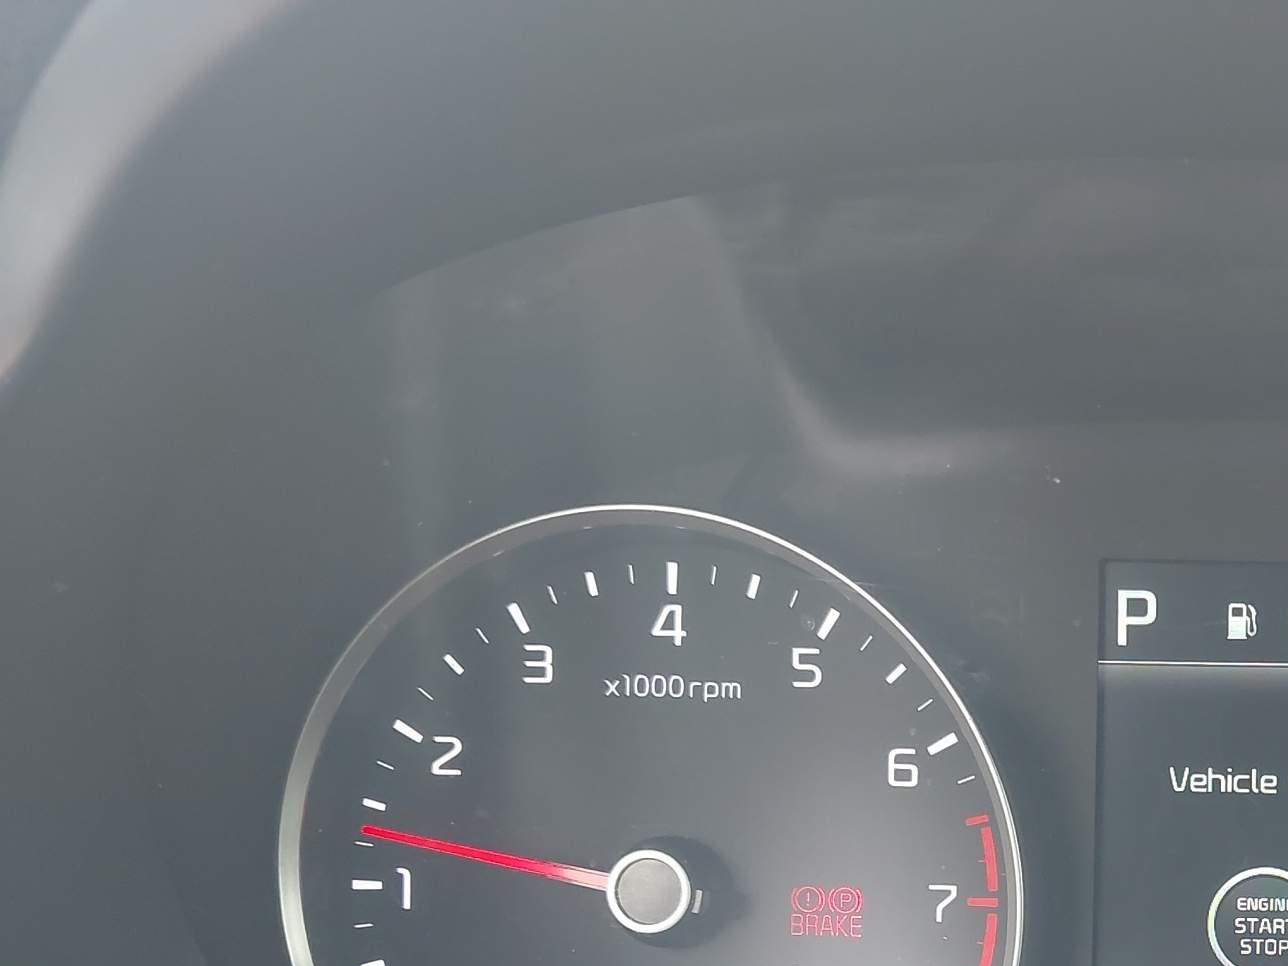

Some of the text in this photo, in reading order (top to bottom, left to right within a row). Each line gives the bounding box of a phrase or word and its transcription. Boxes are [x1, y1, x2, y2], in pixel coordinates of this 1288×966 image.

[651, 605, 686, 646] 4
[1118, 590, 1156, 645] P
[523, 645, 552, 683] 3
[792, 648, 821, 687] 5
[432, 737, 462, 775] 2
[888, 749, 918, 787] 6
[1170, 767, 1277, 793] Vehicle
[396, 868, 411, 909] 1
[929, 885, 957, 922] 7
[790, 913, 863, 938] BRAKE
